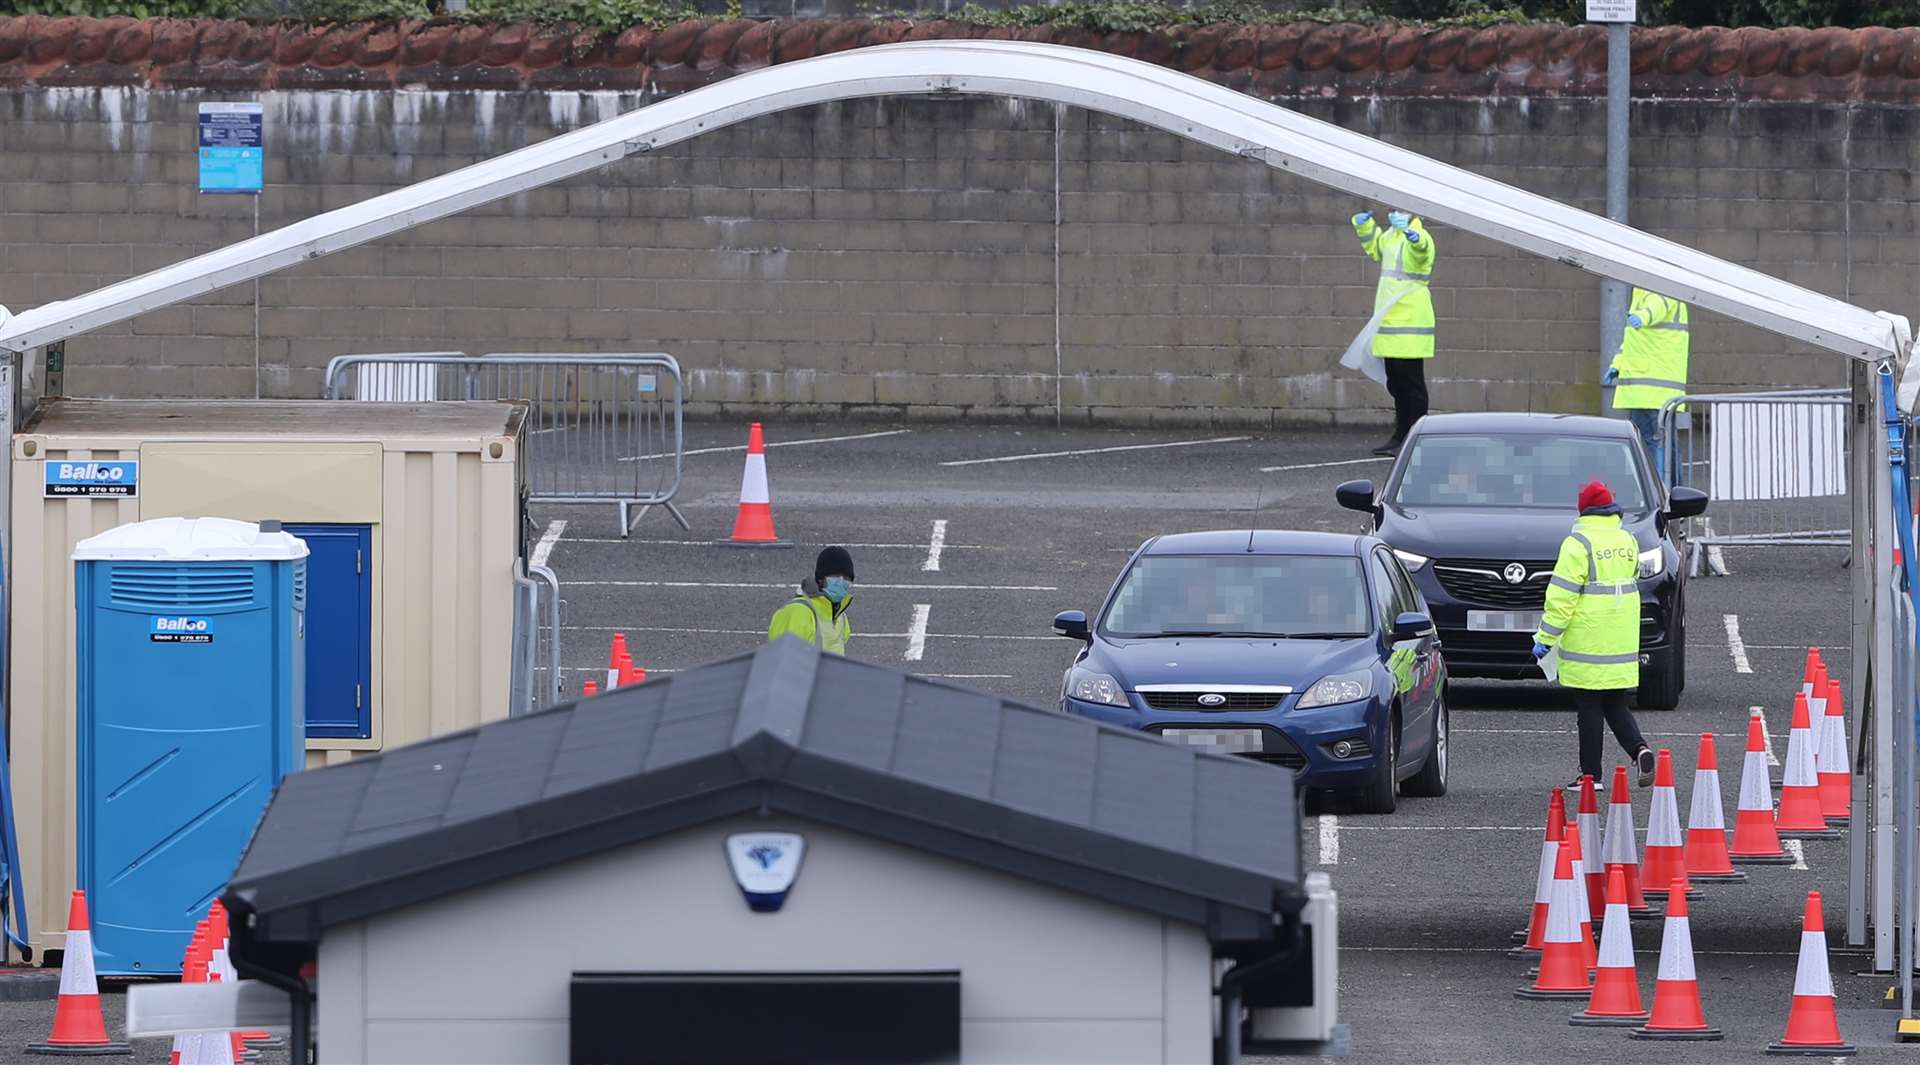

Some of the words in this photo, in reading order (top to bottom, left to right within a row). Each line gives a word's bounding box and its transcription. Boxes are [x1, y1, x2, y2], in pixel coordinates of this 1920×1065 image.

[59, 463, 123, 480] Balloo
[1595, 548, 1634, 561] serco
[156, 617, 207, 631] Balloo
